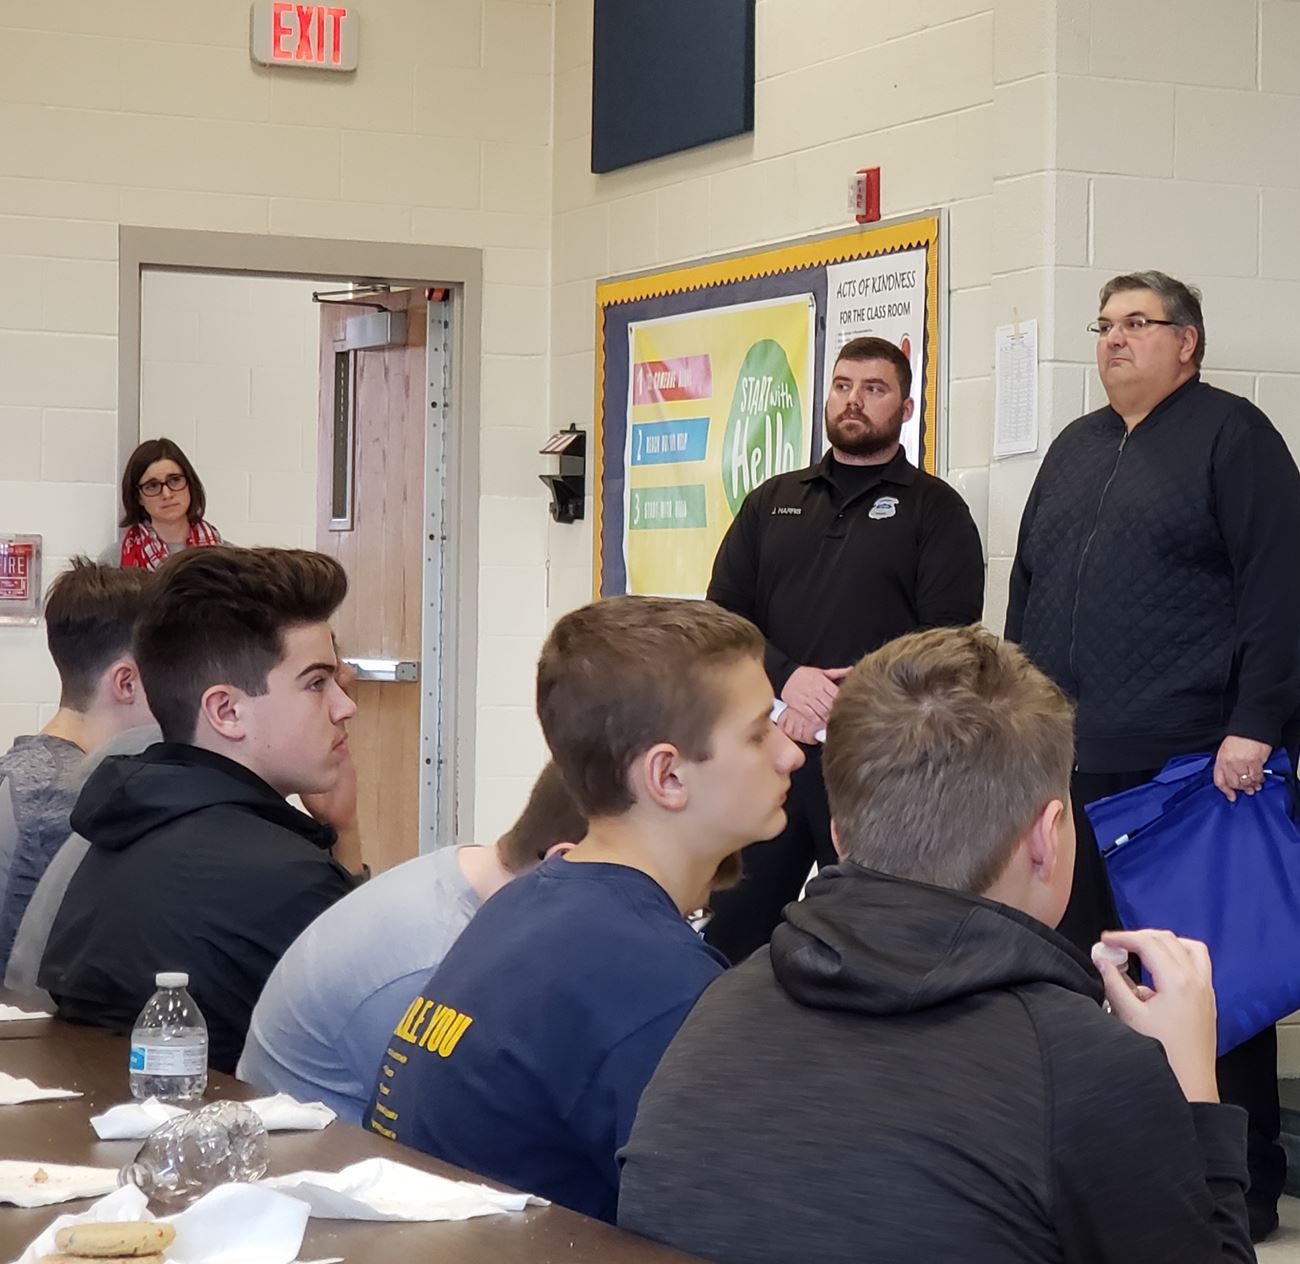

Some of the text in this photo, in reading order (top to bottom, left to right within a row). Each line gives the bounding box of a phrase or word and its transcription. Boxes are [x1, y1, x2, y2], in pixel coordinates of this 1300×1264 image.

[272, 2, 348, 64] EXIT
[836, 270, 916, 299] ACTS OF KINDNESS
[840, 301, 911, 325] FOR THE CLASS ROOM
[741, 375, 793, 416] START with
[731, 411, 794, 499] Hello
[633, 492, 641, 525] 3
[0, 556, 25, 574] IRE
[418, 1004, 473, 1058] YOU
